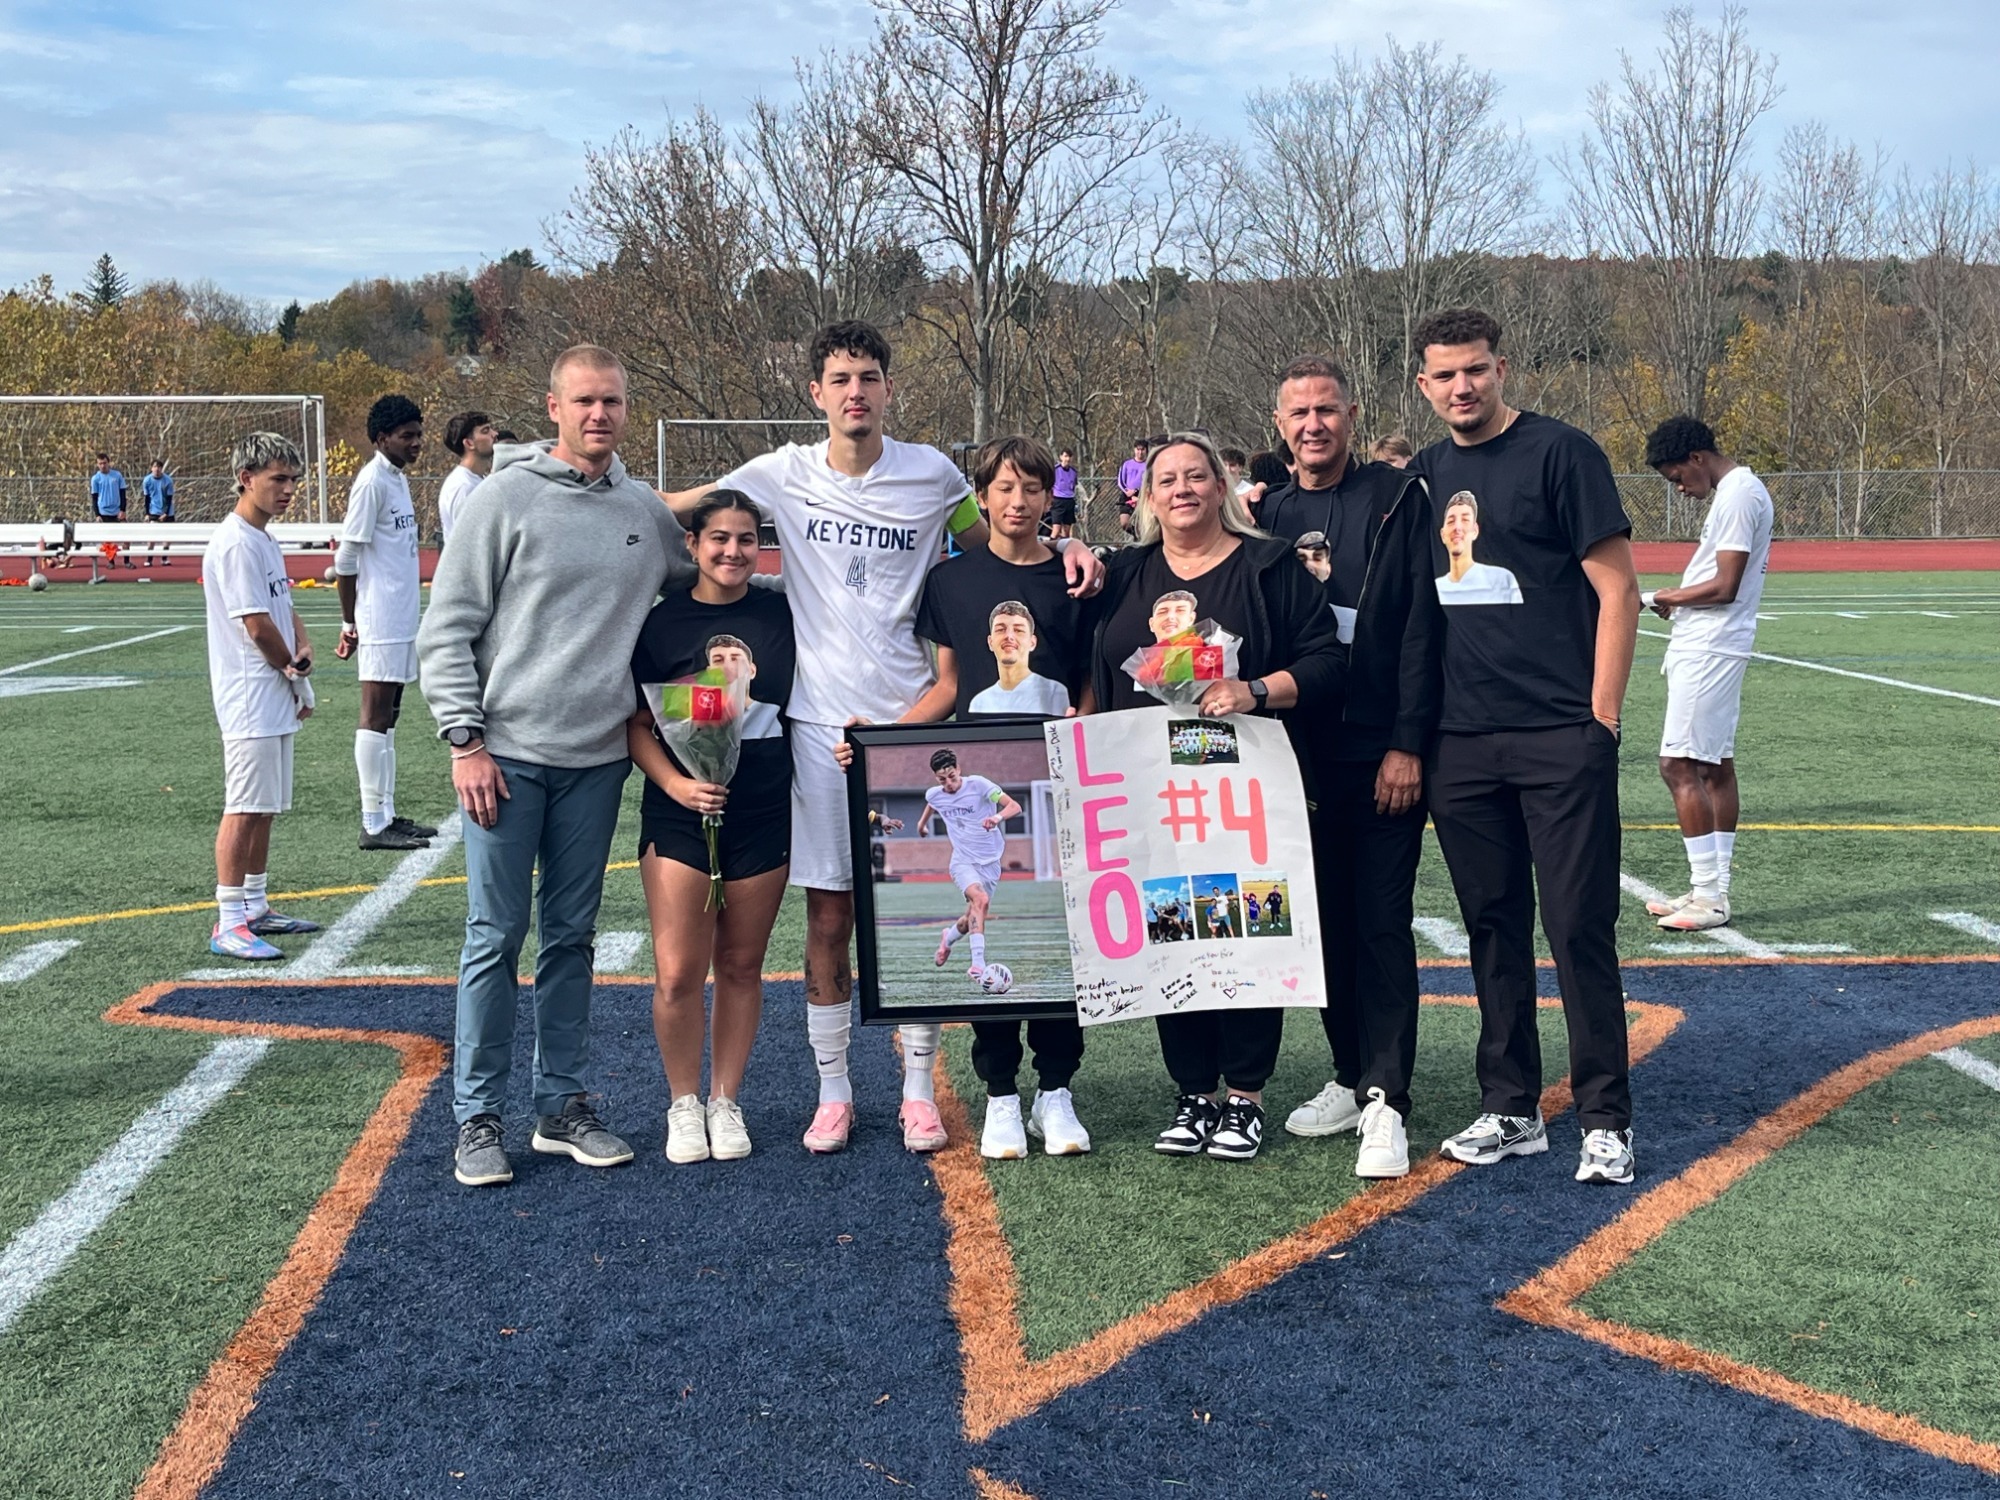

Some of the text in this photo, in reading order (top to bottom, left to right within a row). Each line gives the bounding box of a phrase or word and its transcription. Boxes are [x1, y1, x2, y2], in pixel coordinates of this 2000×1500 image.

[806, 519, 917, 551] KEYSTONE
[846, 555, 868, 598] 4
[1073, 721, 1144, 960] LEO
[1157, 777, 1269, 865] #4
